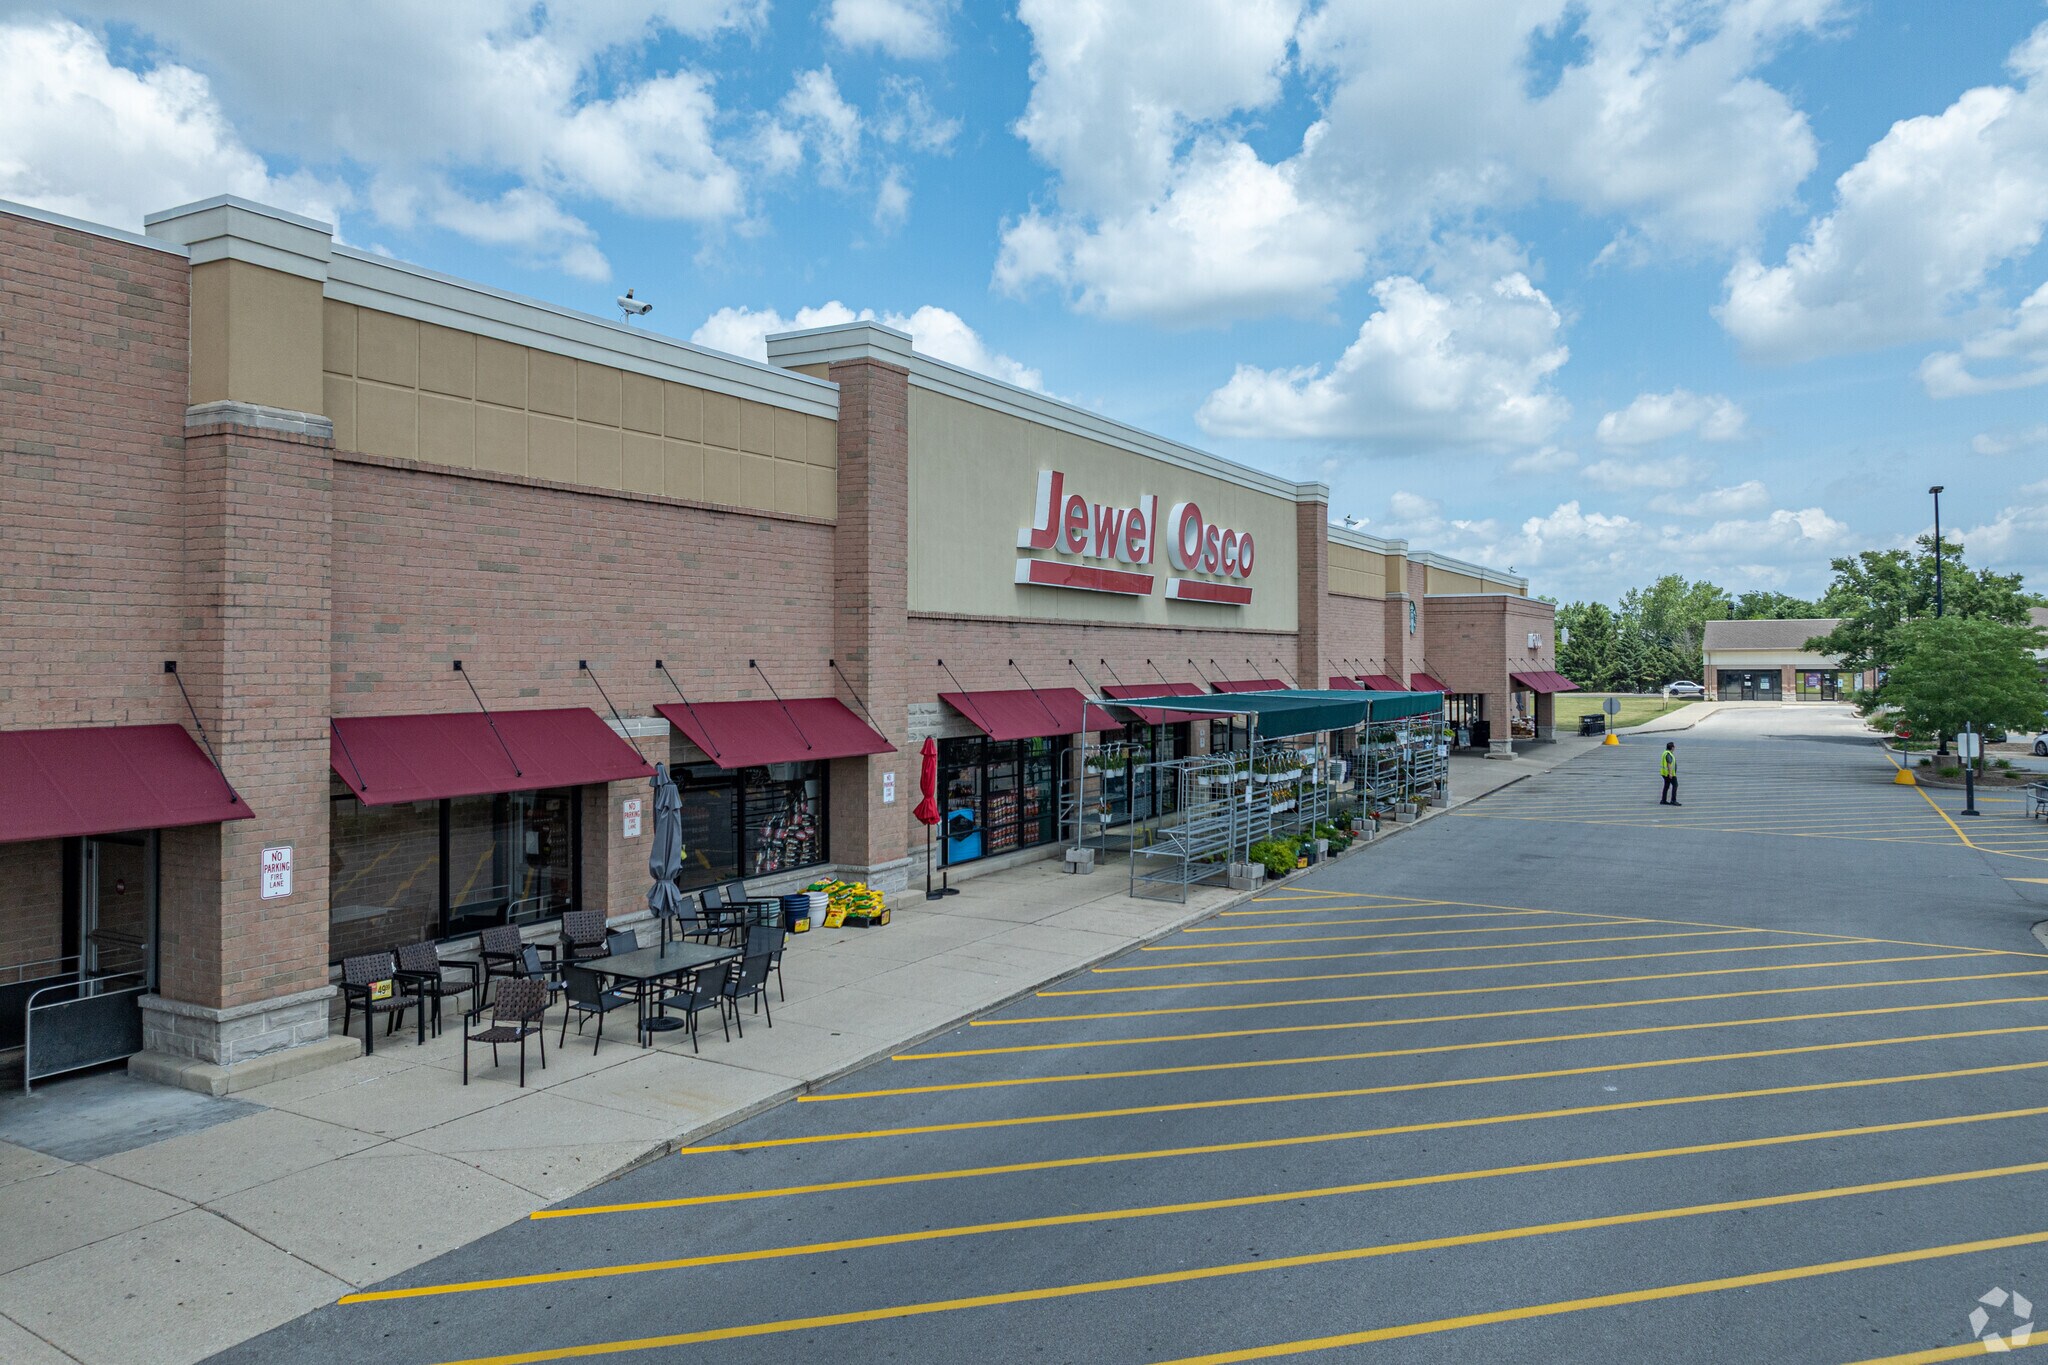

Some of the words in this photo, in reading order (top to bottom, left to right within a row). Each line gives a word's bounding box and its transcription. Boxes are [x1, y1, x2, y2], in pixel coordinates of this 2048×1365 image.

[1024, 469, 1158, 565] Jewel
[1173, 501, 1255, 579] Osco
[271, 851, 283, 862] NO
[264, 861, 290, 873] PARKING
[270, 872, 284, 881] FIRE
[269, 880, 285, 889] LANE
